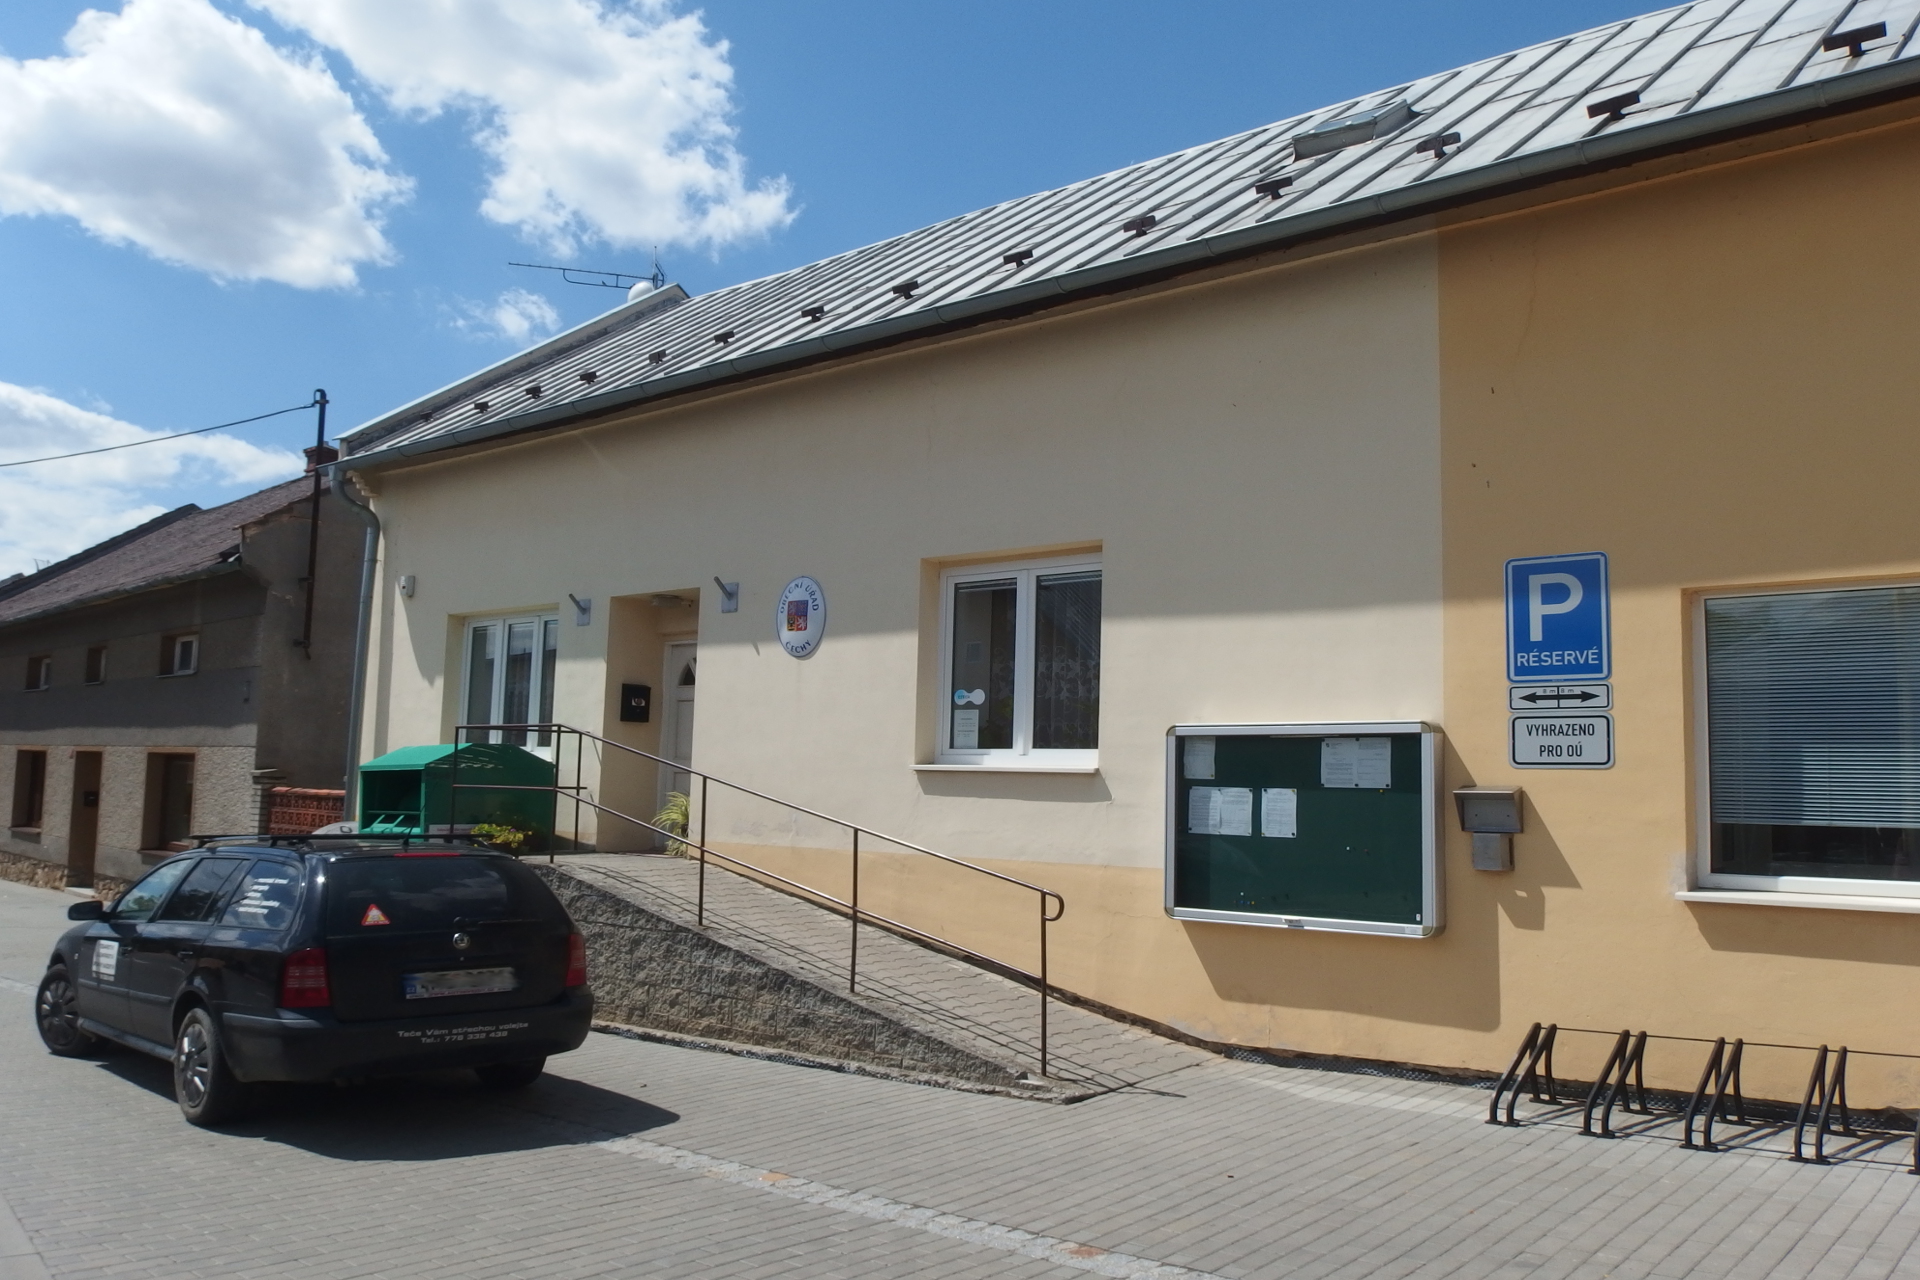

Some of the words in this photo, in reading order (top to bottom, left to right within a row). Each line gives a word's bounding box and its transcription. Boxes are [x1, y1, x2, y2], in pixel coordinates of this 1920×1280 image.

[780, 580, 803, 613] OBECNÍ
[805, 583, 820, 611] ÚŘAD
[1528, 572, 1583, 642] P
[785, 639, 811, 654] ČECHY
[1517, 646, 1599, 667] RÉSERVÉ
[1526, 723, 1595, 737] VYHRAZENO
[1539, 744, 1563, 757] PRO
[1567, 741, 1583, 757] OÚ
[426, 1028, 449, 1036] Vám
[452, 1025, 496, 1034] střechou
[498, 1022, 529, 1030] volejte
